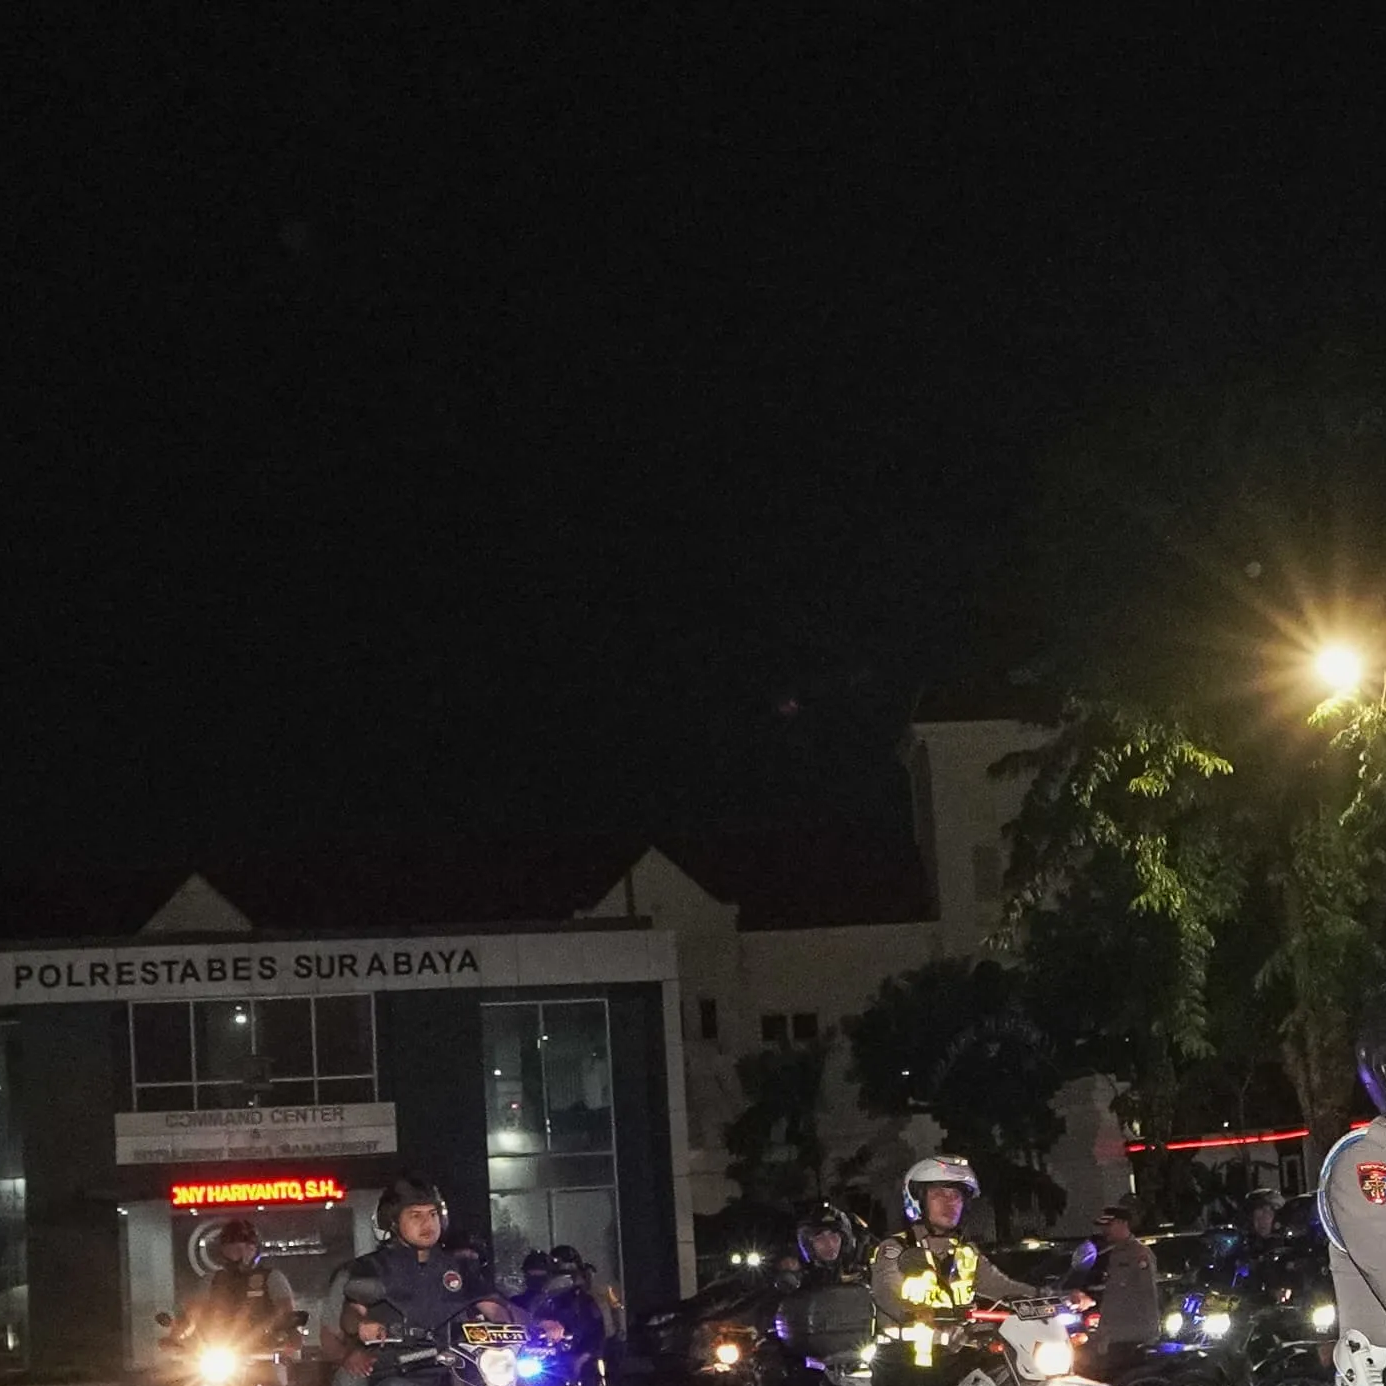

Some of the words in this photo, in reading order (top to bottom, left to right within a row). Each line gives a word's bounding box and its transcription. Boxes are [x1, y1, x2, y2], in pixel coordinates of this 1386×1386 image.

[15, 955, 277, 989] POLRESTABES
[294, 949, 479, 979] SURABAYA
[165, 1110, 262, 1128] COMMAND
[270, 1107, 345, 1124] CENTER
[210, 1182, 303, 1203] HARIYANTO,
